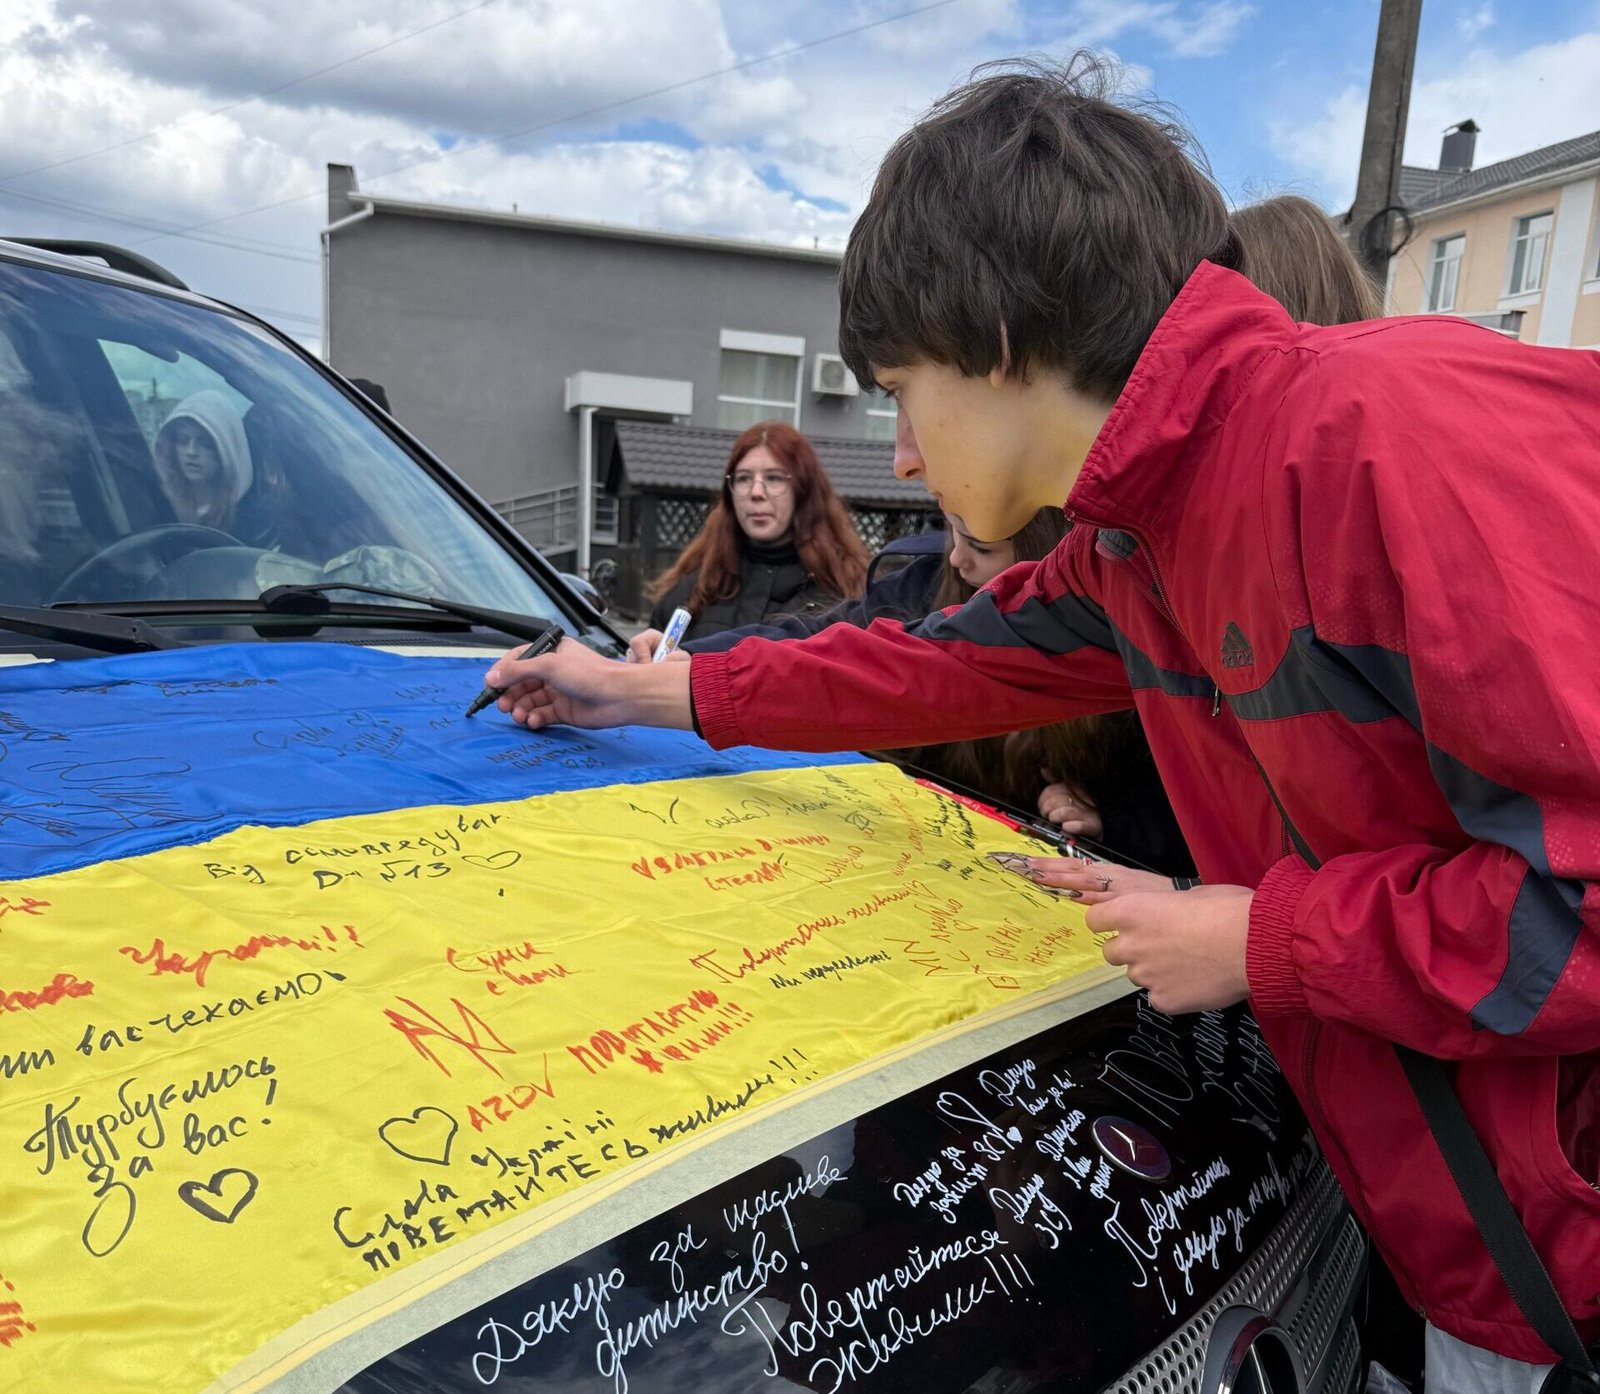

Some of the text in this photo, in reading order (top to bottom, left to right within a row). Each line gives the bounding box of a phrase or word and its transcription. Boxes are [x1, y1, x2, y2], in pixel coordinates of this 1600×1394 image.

[466, 1051, 556, 1134] AZOV
[472, 1267, 626, 1386] Дякую
[650, 1224, 708, 1293] за
